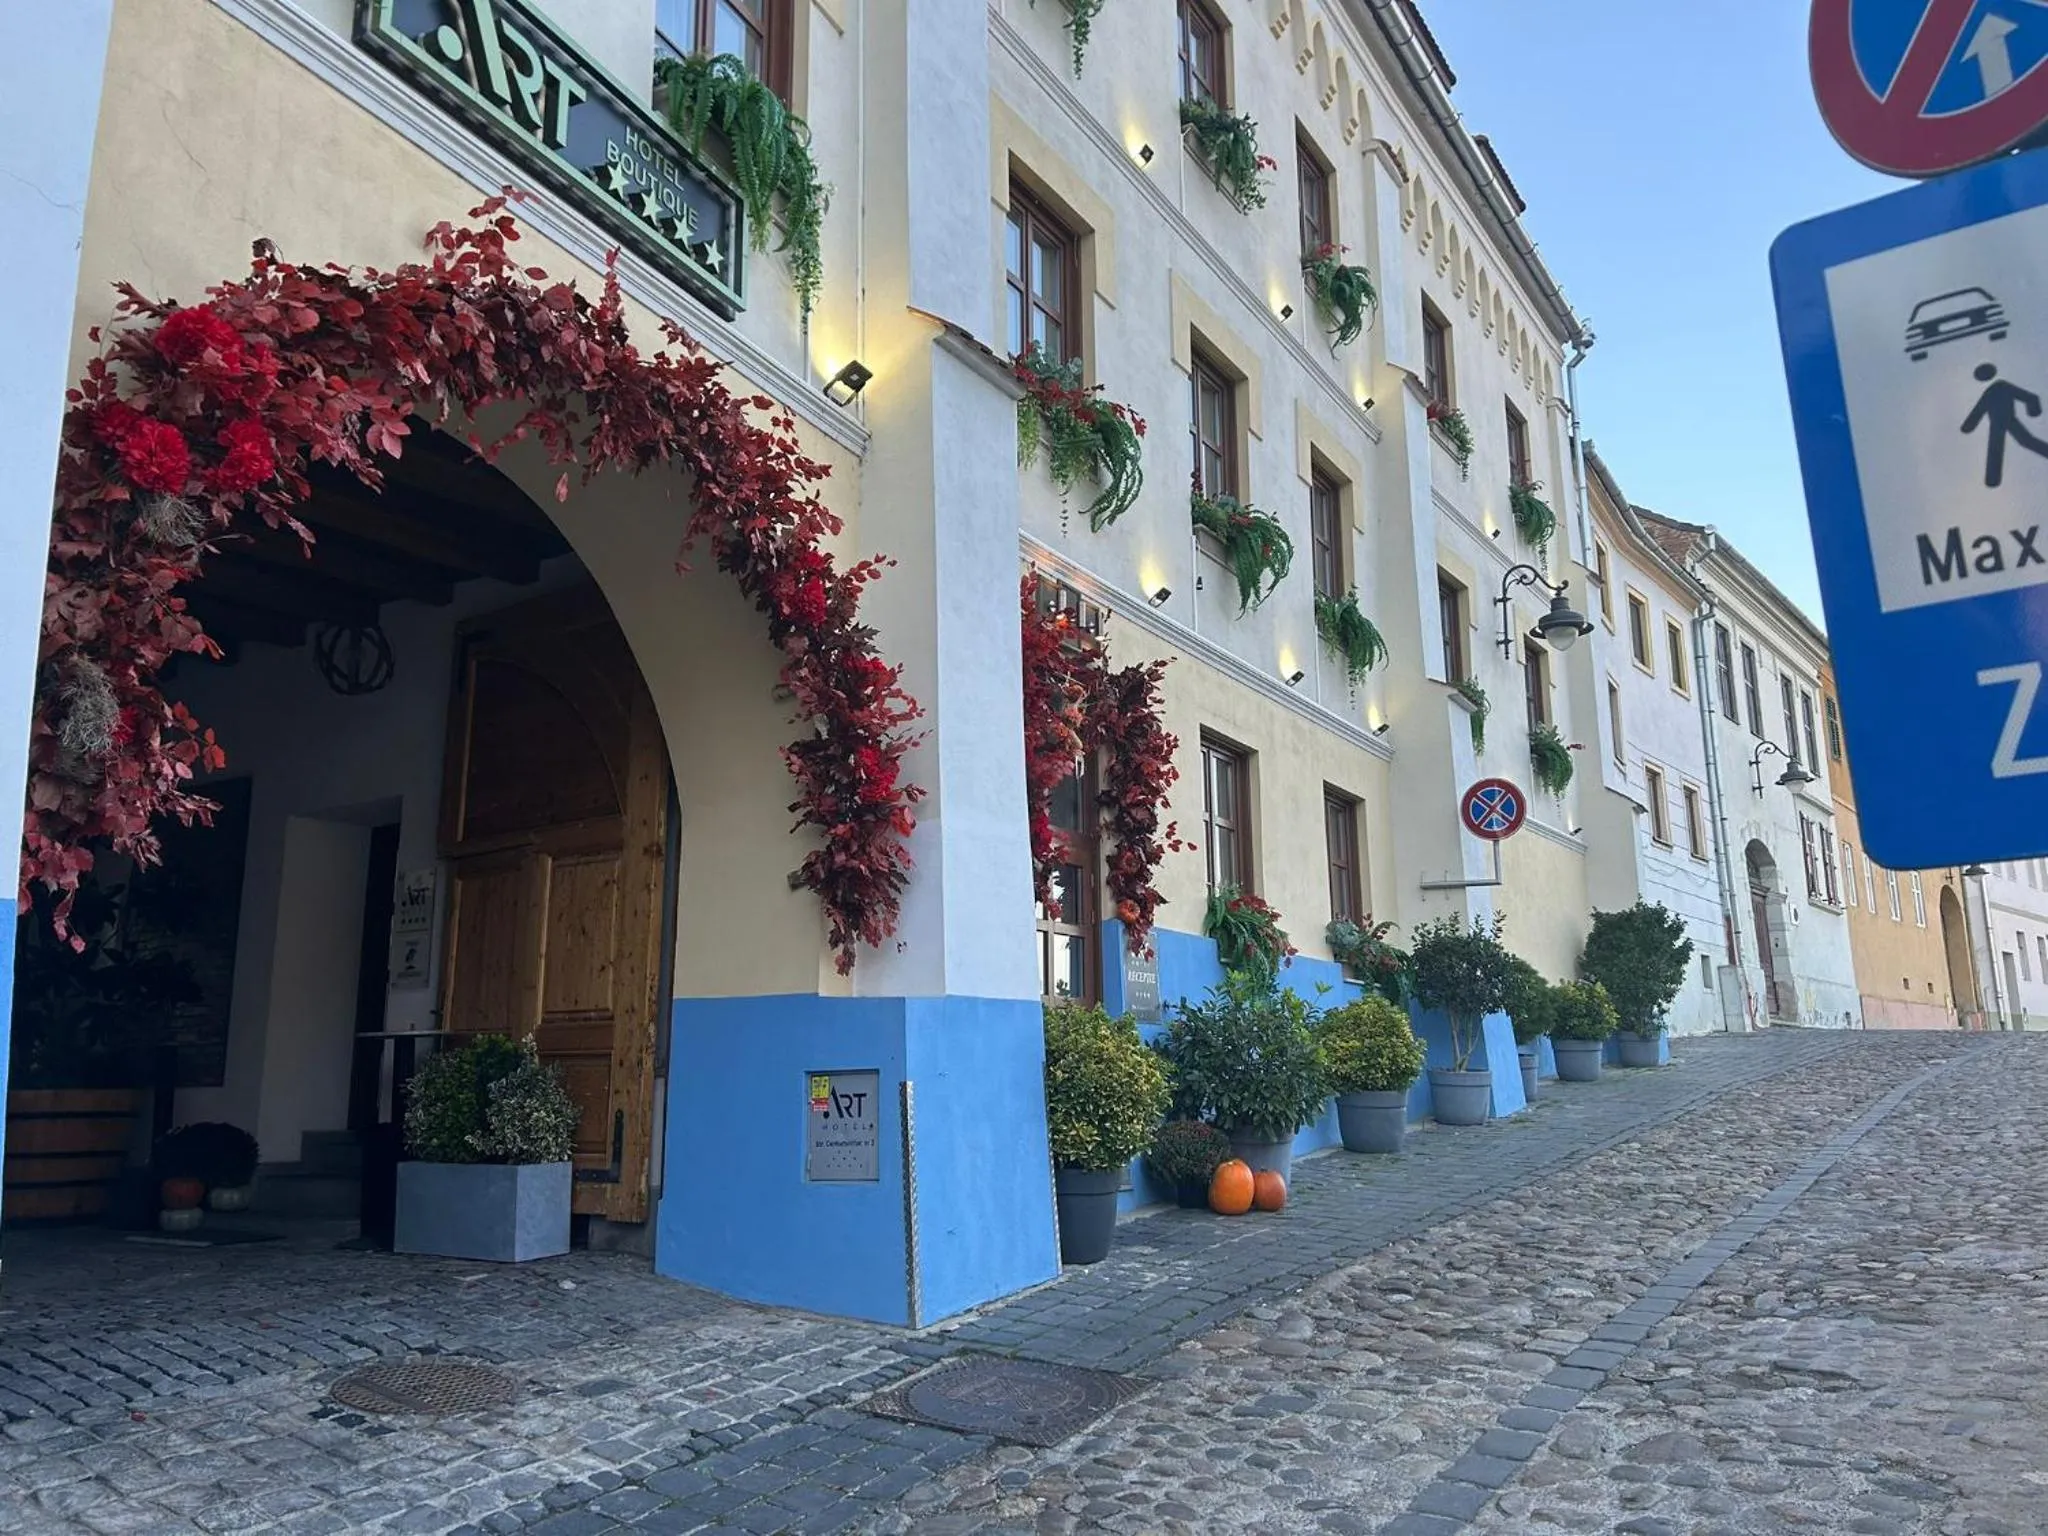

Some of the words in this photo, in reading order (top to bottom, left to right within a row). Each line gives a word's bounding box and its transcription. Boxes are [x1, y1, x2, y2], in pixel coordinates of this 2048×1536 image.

[607, 139, 699, 230] BOUTIQUE
[626, 125, 685, 192] HOTEL
[1916, 524, 2047, 587] Max
[1976, 660, 2048, 779] Z
[823, 1085, 867, 1119] ART
